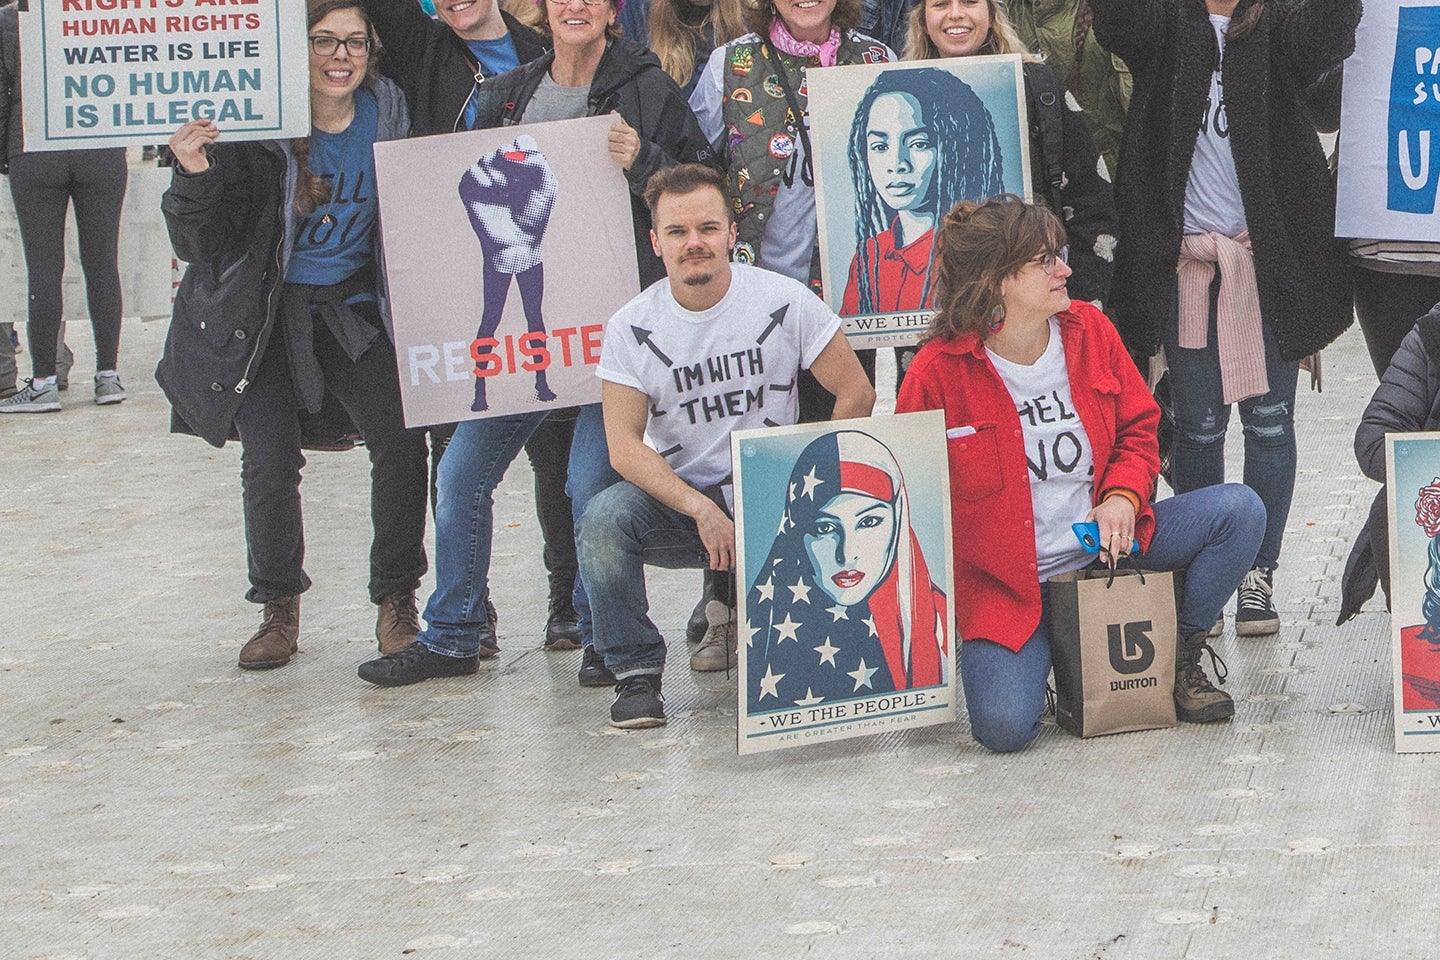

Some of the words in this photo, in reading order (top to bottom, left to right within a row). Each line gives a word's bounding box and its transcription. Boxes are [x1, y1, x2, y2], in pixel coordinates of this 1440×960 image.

[63, 17, 156, 37] HUMAN
[166, 13, 260, 32] RIGHTS
[64, 44, 158, 64] WATER
[169, 43, 192, 60] IS
[203, 40, 259, 59] LIFE
[64, 74, 115, 98] NO
[129, 68, 261, 95] HUMAN
[65, 104, 98, 128] IS
[113, 98, 263, 126] ILLEGAL
[855, 318, 887, 330] WE
[893, 315, 930, 327] THE
[868, 334, 913, 342] PROTEC
[407, 324, 603, 386] RESISTE
[672, 362, 704, 393] I'M
[707, 347, 764, 383] WITH
[680, 385, 764, 424] THEM
[1110, 677, 1157, 692] BURTON
[770, 713, 802, 728] WE
[808, 705, 847, 722] THE
[853, 693, 926, 715] PEOPLE
[778, 733, 799, 742] ARE
[804, 725, 852, 738] GREATER
[857, 719, 885, 728] THAN
[890, 714, 916, 724] FEAR
